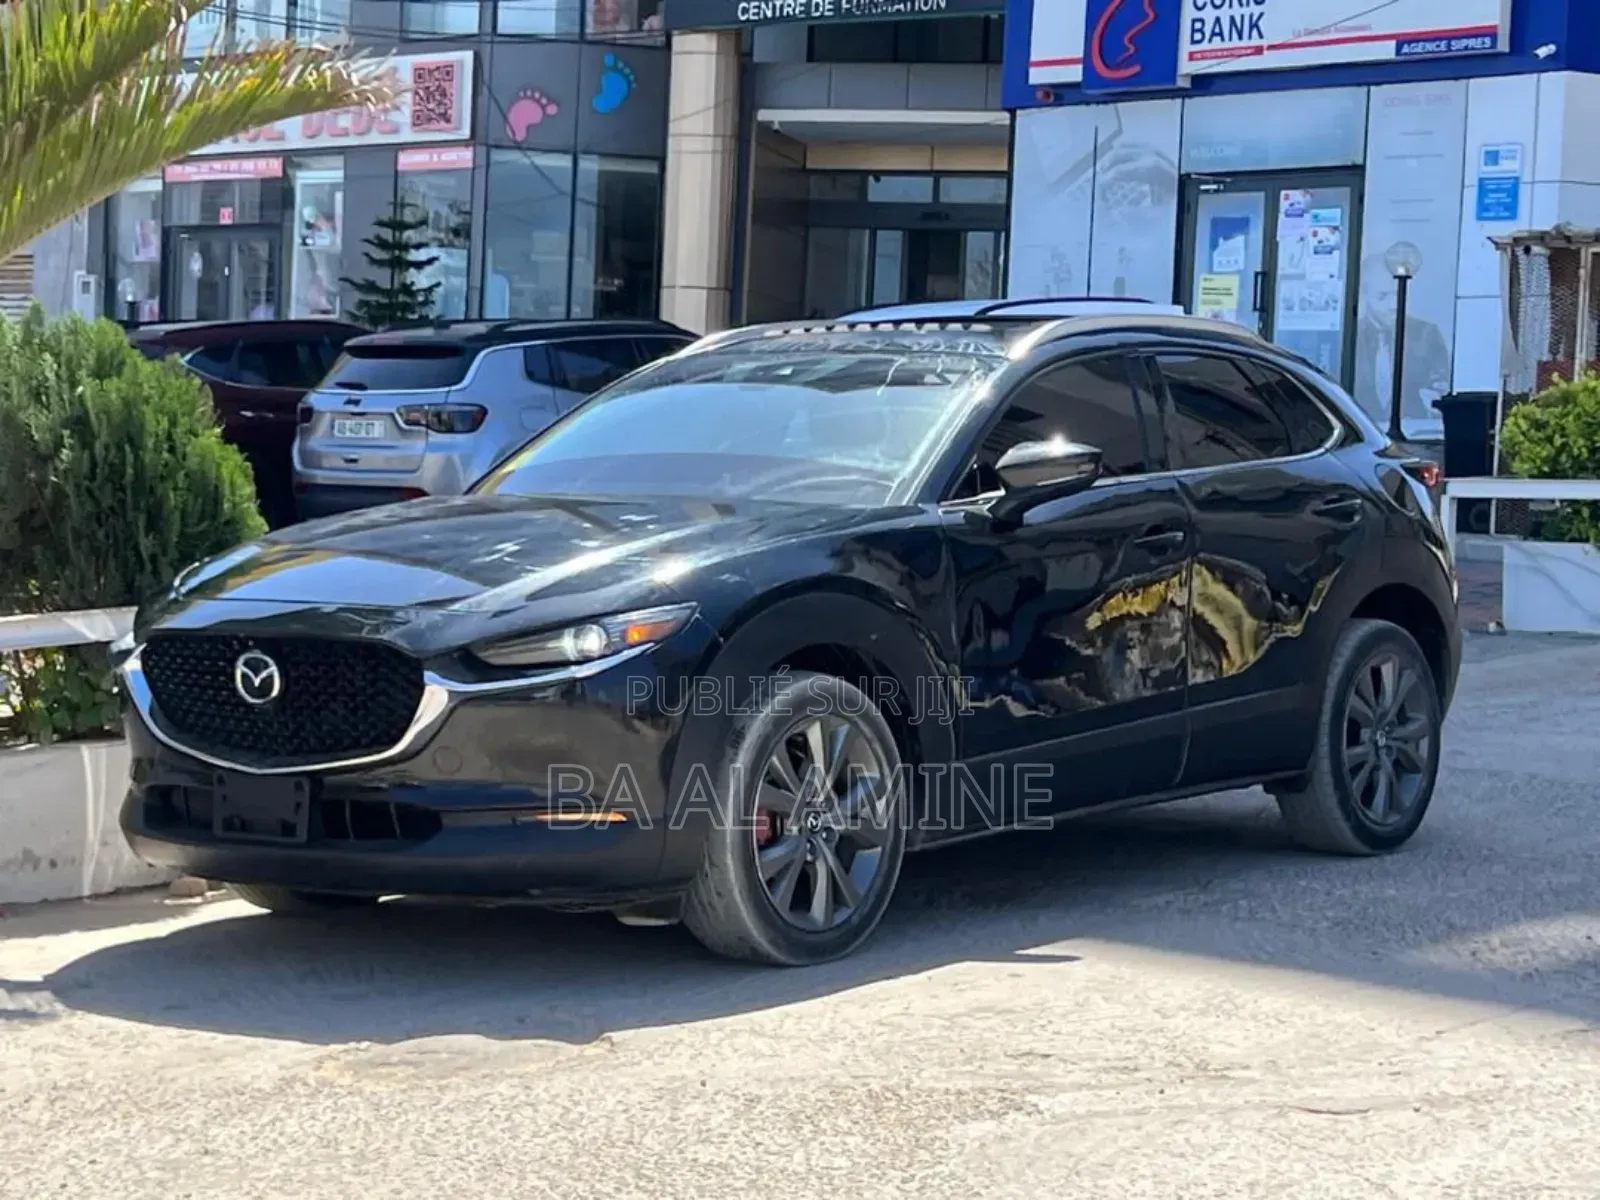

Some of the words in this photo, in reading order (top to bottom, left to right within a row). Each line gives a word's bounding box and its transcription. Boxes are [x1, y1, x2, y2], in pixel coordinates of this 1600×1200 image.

[737, 0, 805, 20] CENTRE
[811, 0, 835, 16] DE
[1190, 12, 1265, 45] BANK
[1401, 39, 1448, 54] AGENCE
[1450, 37, 1492, 51] SIPRES
